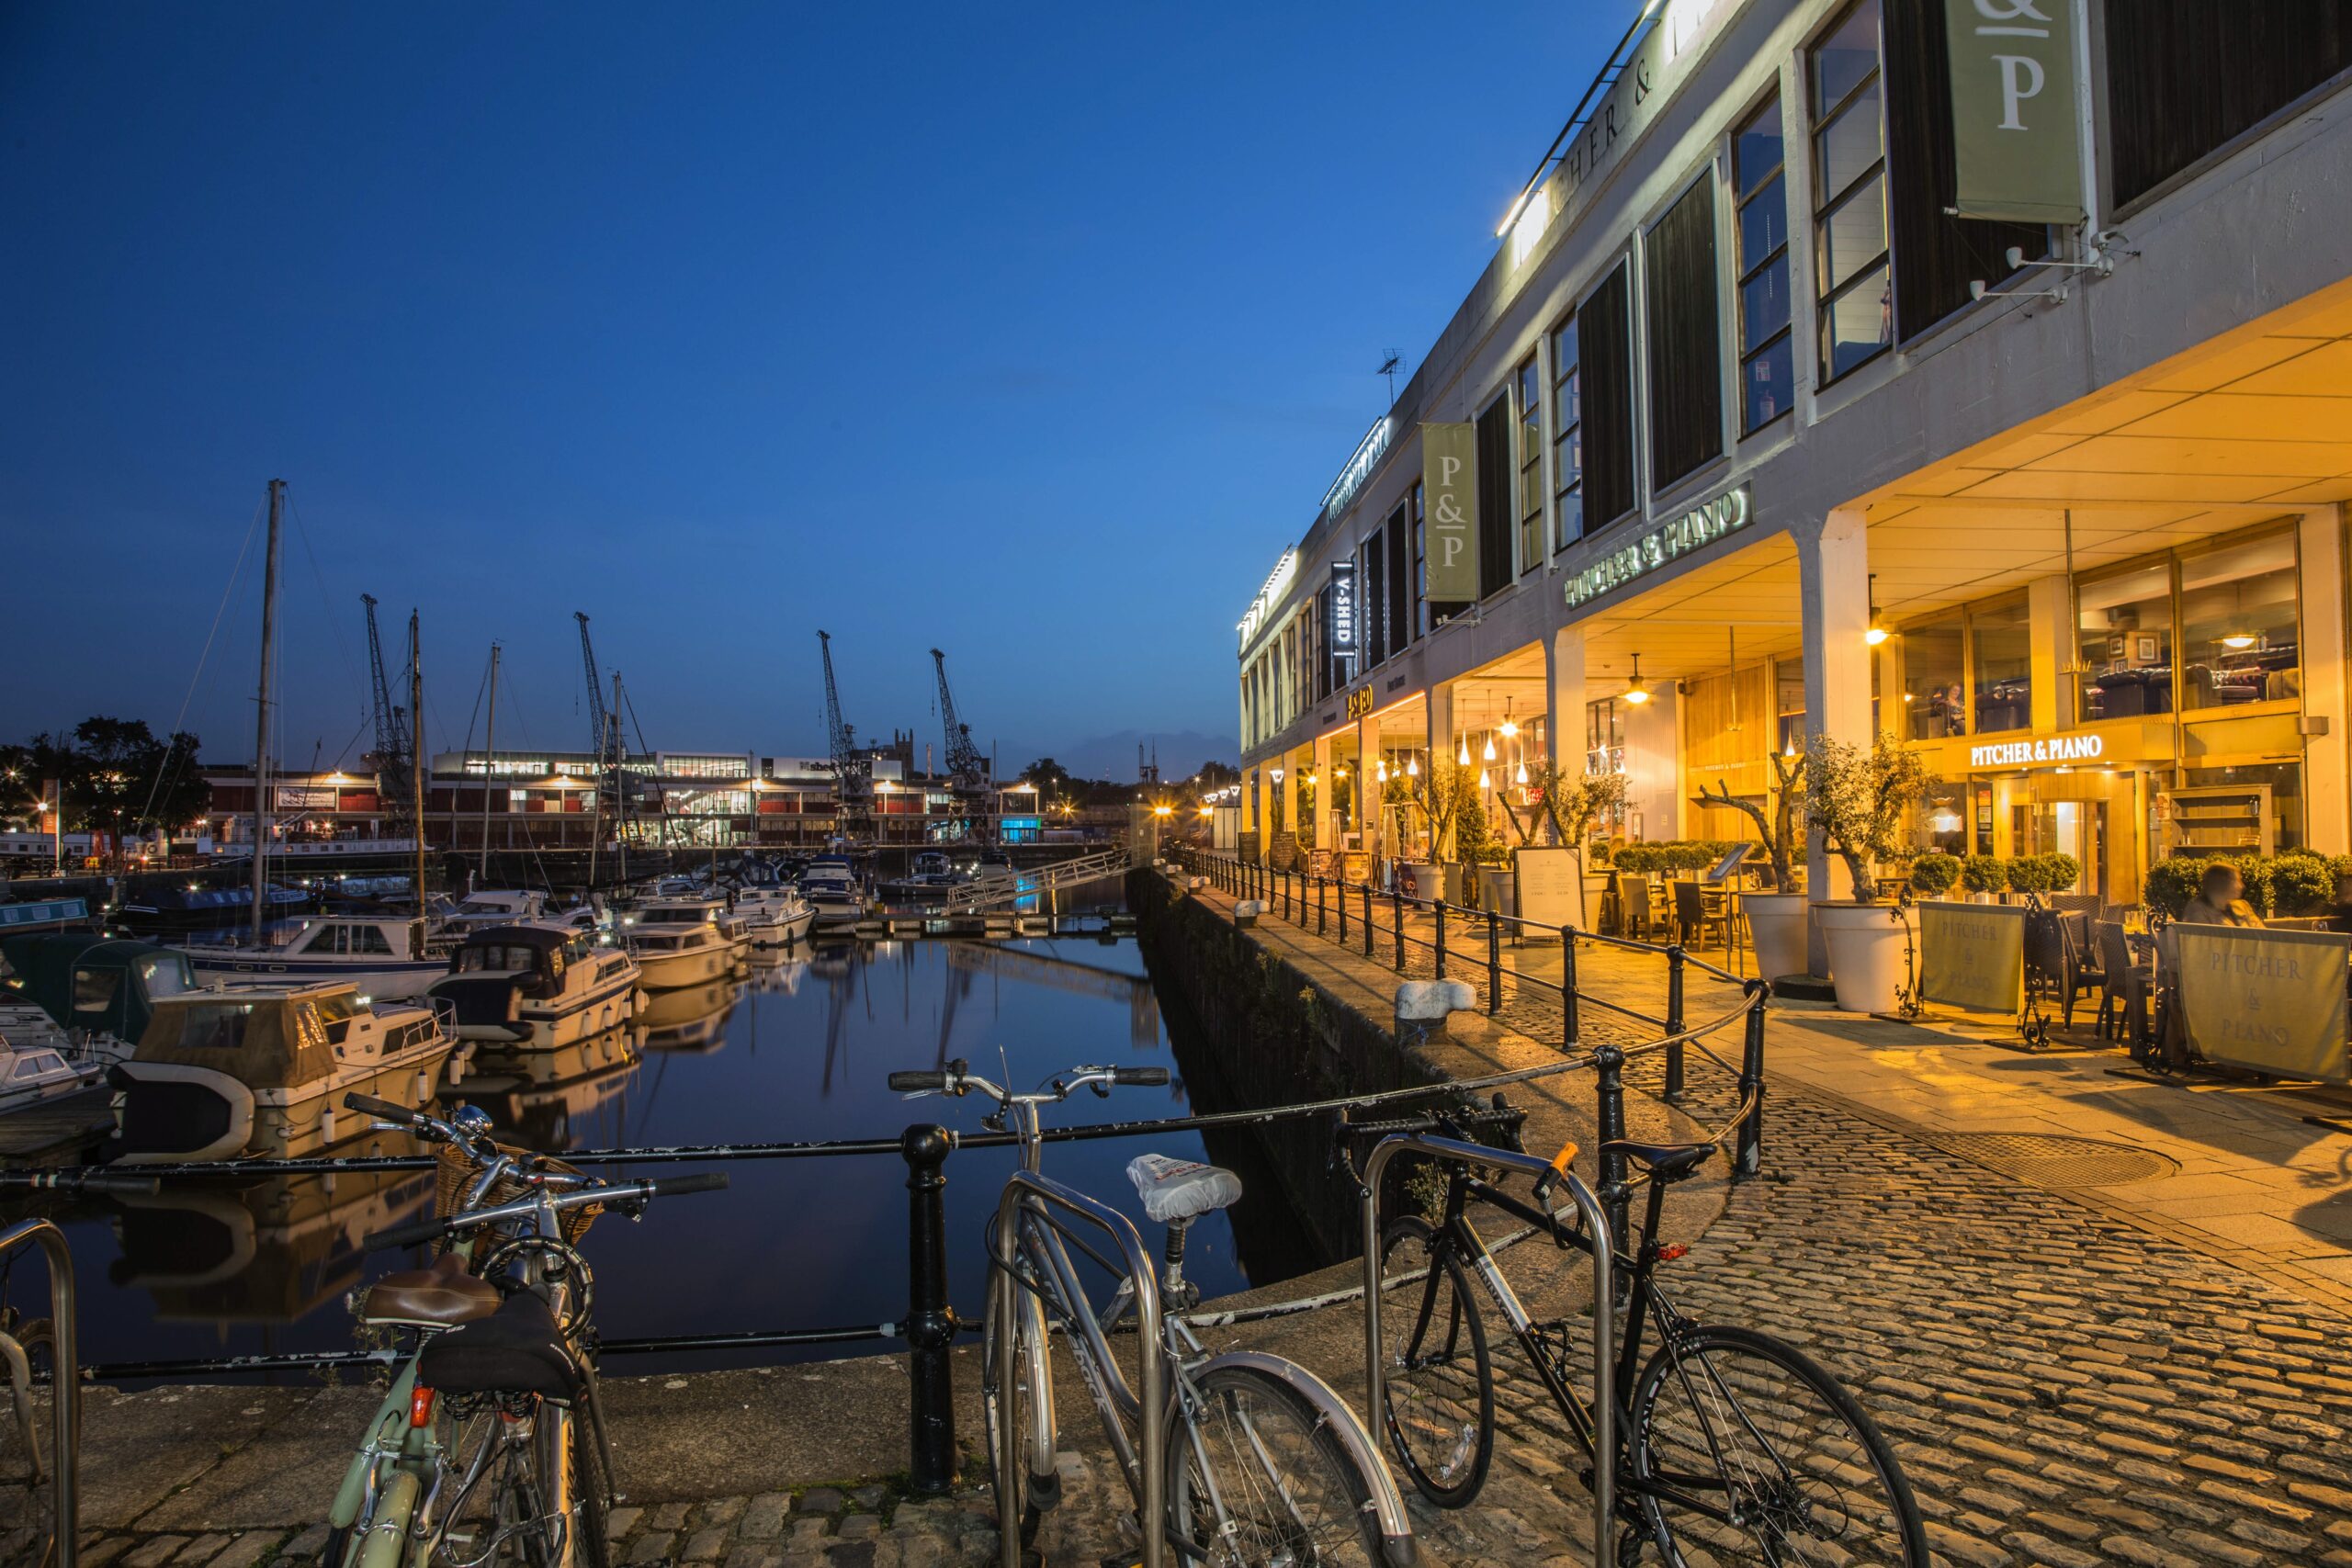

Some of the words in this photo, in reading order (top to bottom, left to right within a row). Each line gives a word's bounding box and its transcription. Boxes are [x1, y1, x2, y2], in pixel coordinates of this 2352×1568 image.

[1634, 58, 1653, 107] &
[1991, 55, 2044, 130] P
[1439, 456, 1461, 487] P
[1435, 493, 1467, 525] &
[1442, 536, 1464, 567] P
[1565, 546, 1639, 604] PITCHER
[1642, 536, 1658, 564] &
[1664, 491, 1743, 553] PIANO
[1337, 578, 1351, 643] V-SHED
[1971, 741, 2033, 766] PITCHER
[2034, 740, 2047, 761] &
[2048, 735, 2102, 760] PIANO
[1942, 921, 1997, 942] PITCHER
[1951, 971, 1993, 991] PIANO
[2211, 953, 2303, 980] PITCHER
[2248, 988, 2261, 1007] &
[2222, 1019, 2291, 1046] PIANO
